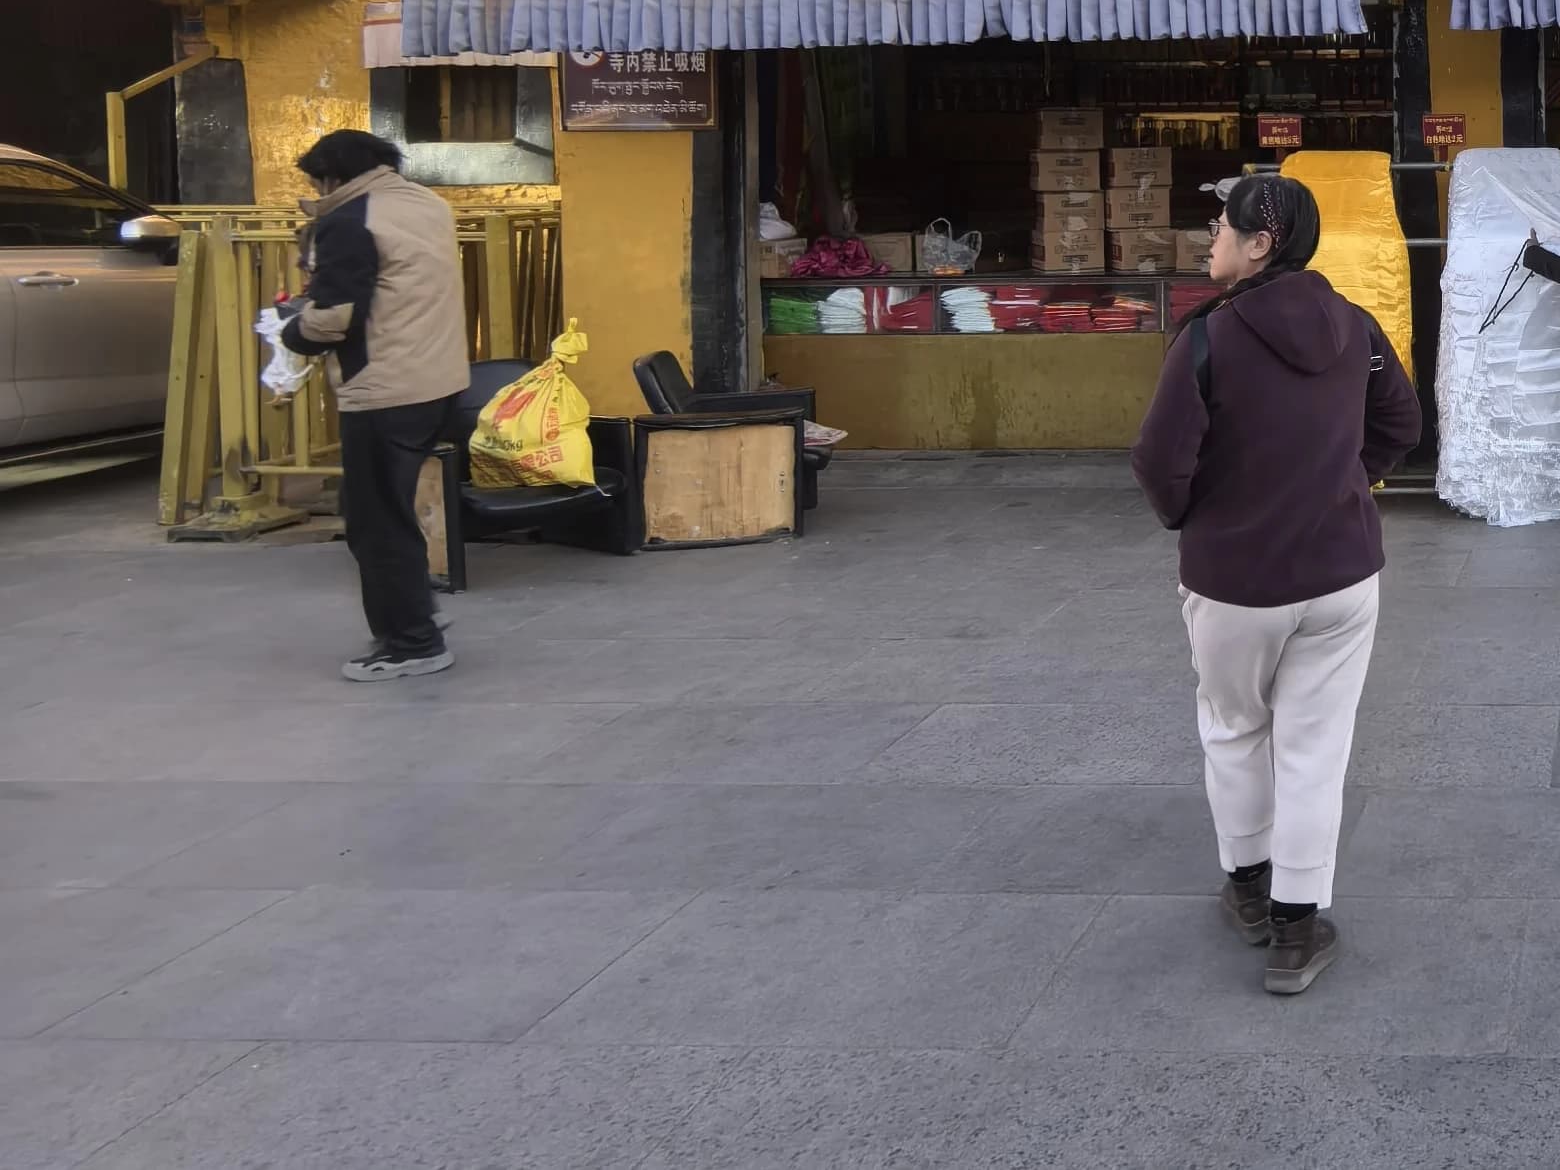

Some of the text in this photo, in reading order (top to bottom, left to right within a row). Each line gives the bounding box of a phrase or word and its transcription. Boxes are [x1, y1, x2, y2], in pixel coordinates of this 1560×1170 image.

[608, 52, 706, 73] 寺内禁止吸烟
